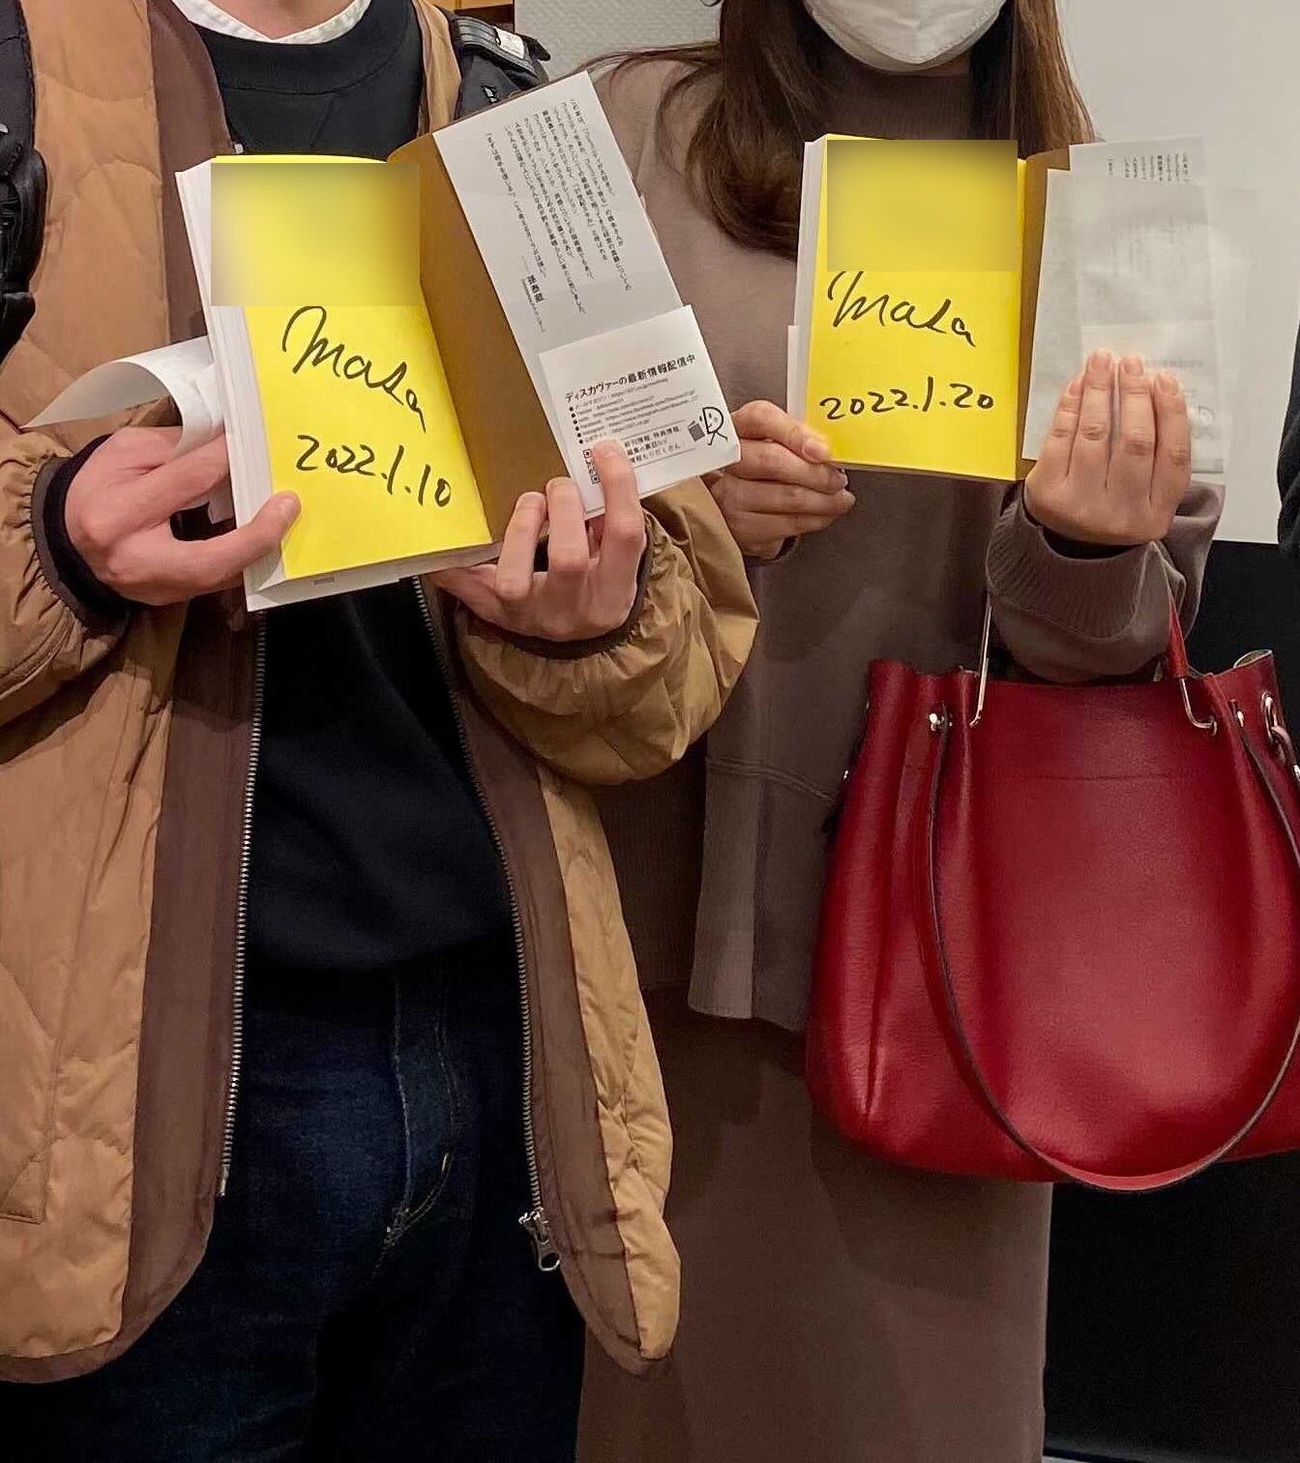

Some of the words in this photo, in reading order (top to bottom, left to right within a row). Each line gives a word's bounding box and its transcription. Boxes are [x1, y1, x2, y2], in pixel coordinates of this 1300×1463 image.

[565, 354, 696, 404] ディスカヴァーの最新情報配信中
[295, 435, 453, 507] 2022.1.10
